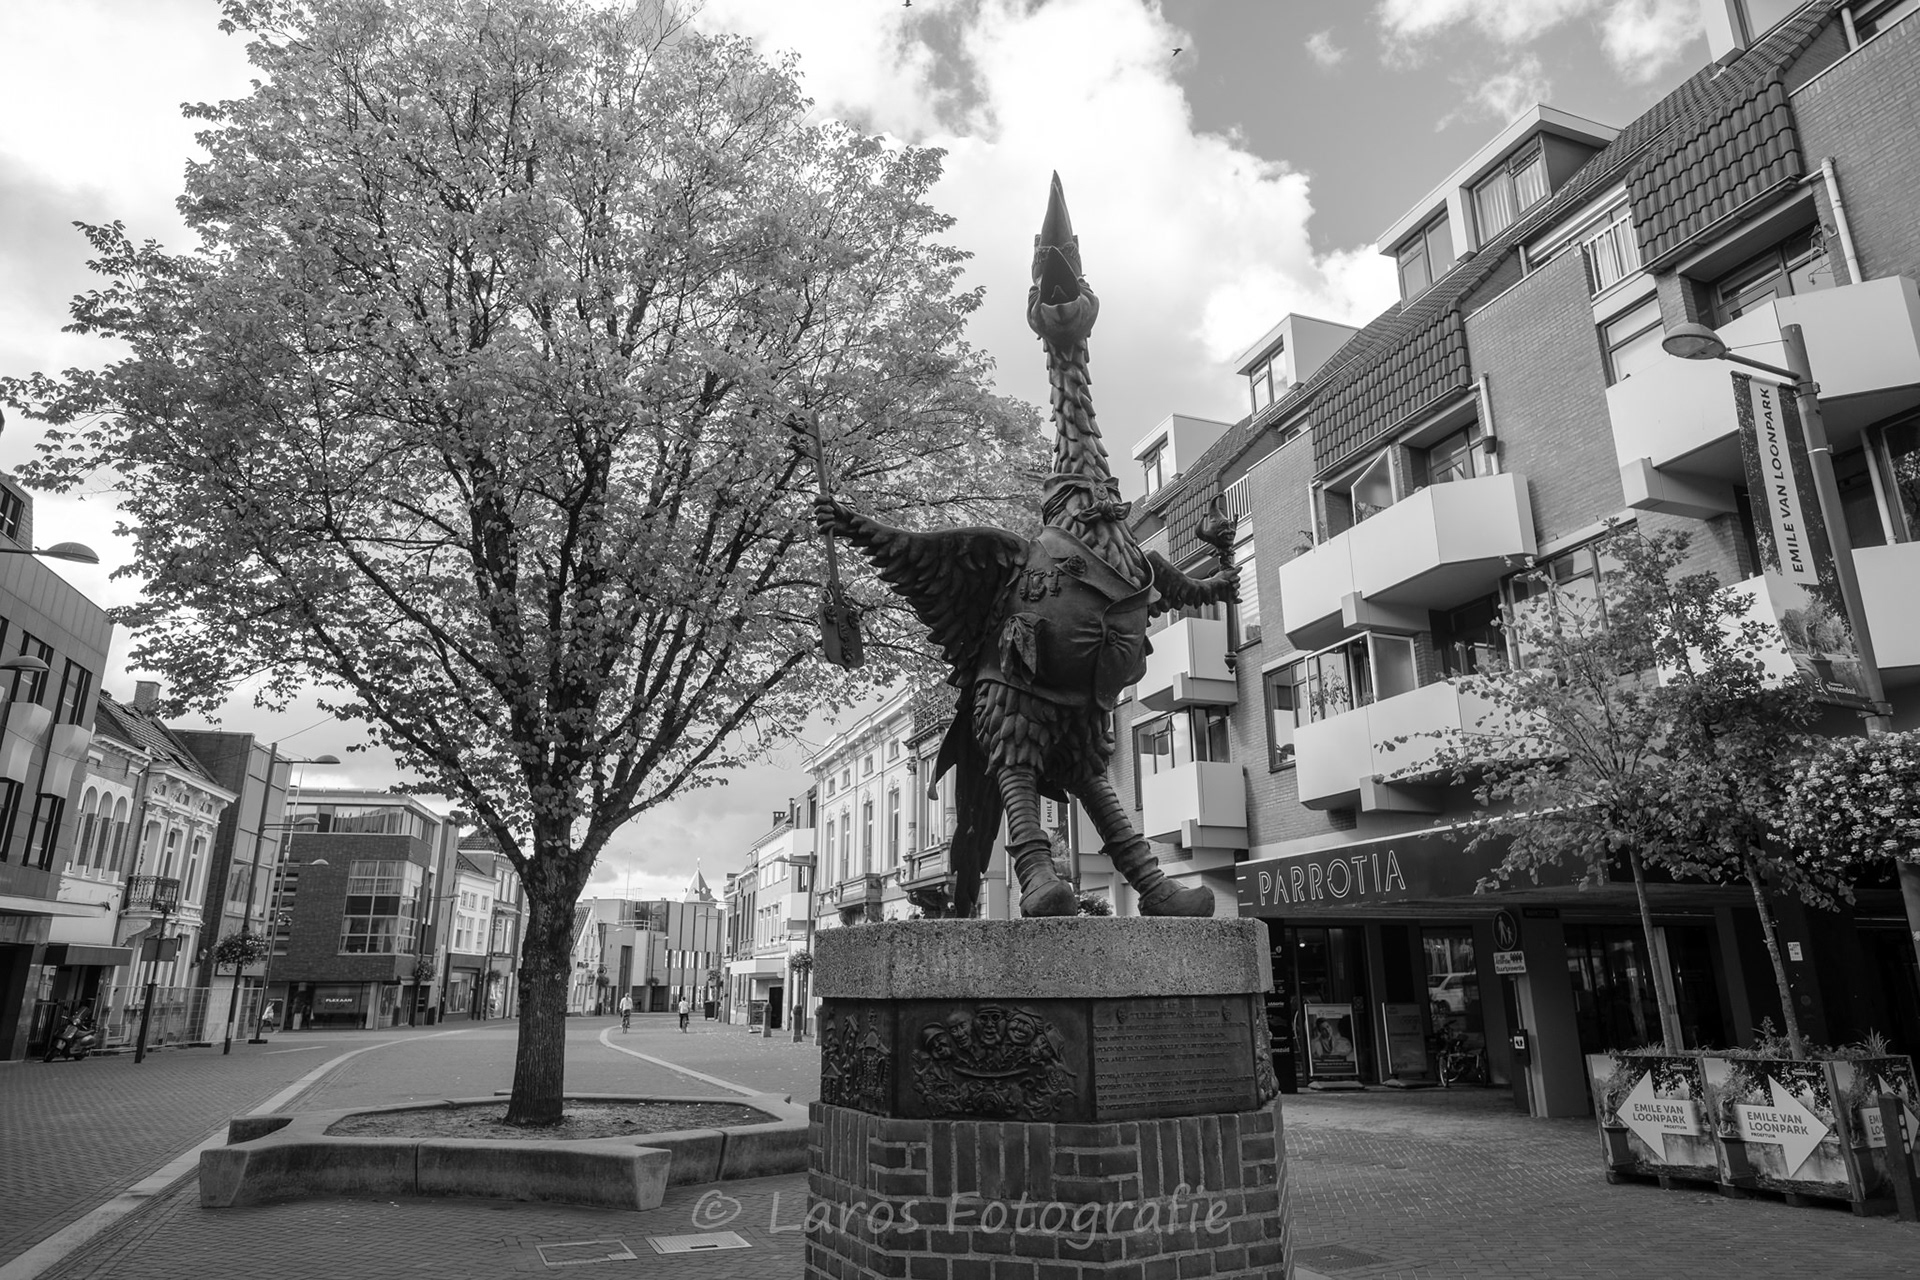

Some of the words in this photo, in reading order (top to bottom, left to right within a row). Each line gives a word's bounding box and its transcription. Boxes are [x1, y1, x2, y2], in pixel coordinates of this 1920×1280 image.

[1759, 388, 1783, 480] LOONPARK
[1776, 485, 1793, 519] VAN
[1785, 522, 1804, 574] EMILE
[1258, 850, 1406, 906] PARROTIA
[1633, 1112, 1686, 1125] LOONPARK
[1634, 1103, 1662, 1114] EMILE
[1663, 1106, 1683, 1115] VAN
[1747, 1111, 1778, 1123] EMILE
[1779, 1113, 1802, 1124] VAN
[1749, 1121, 1809, 1136] LOONPARK
